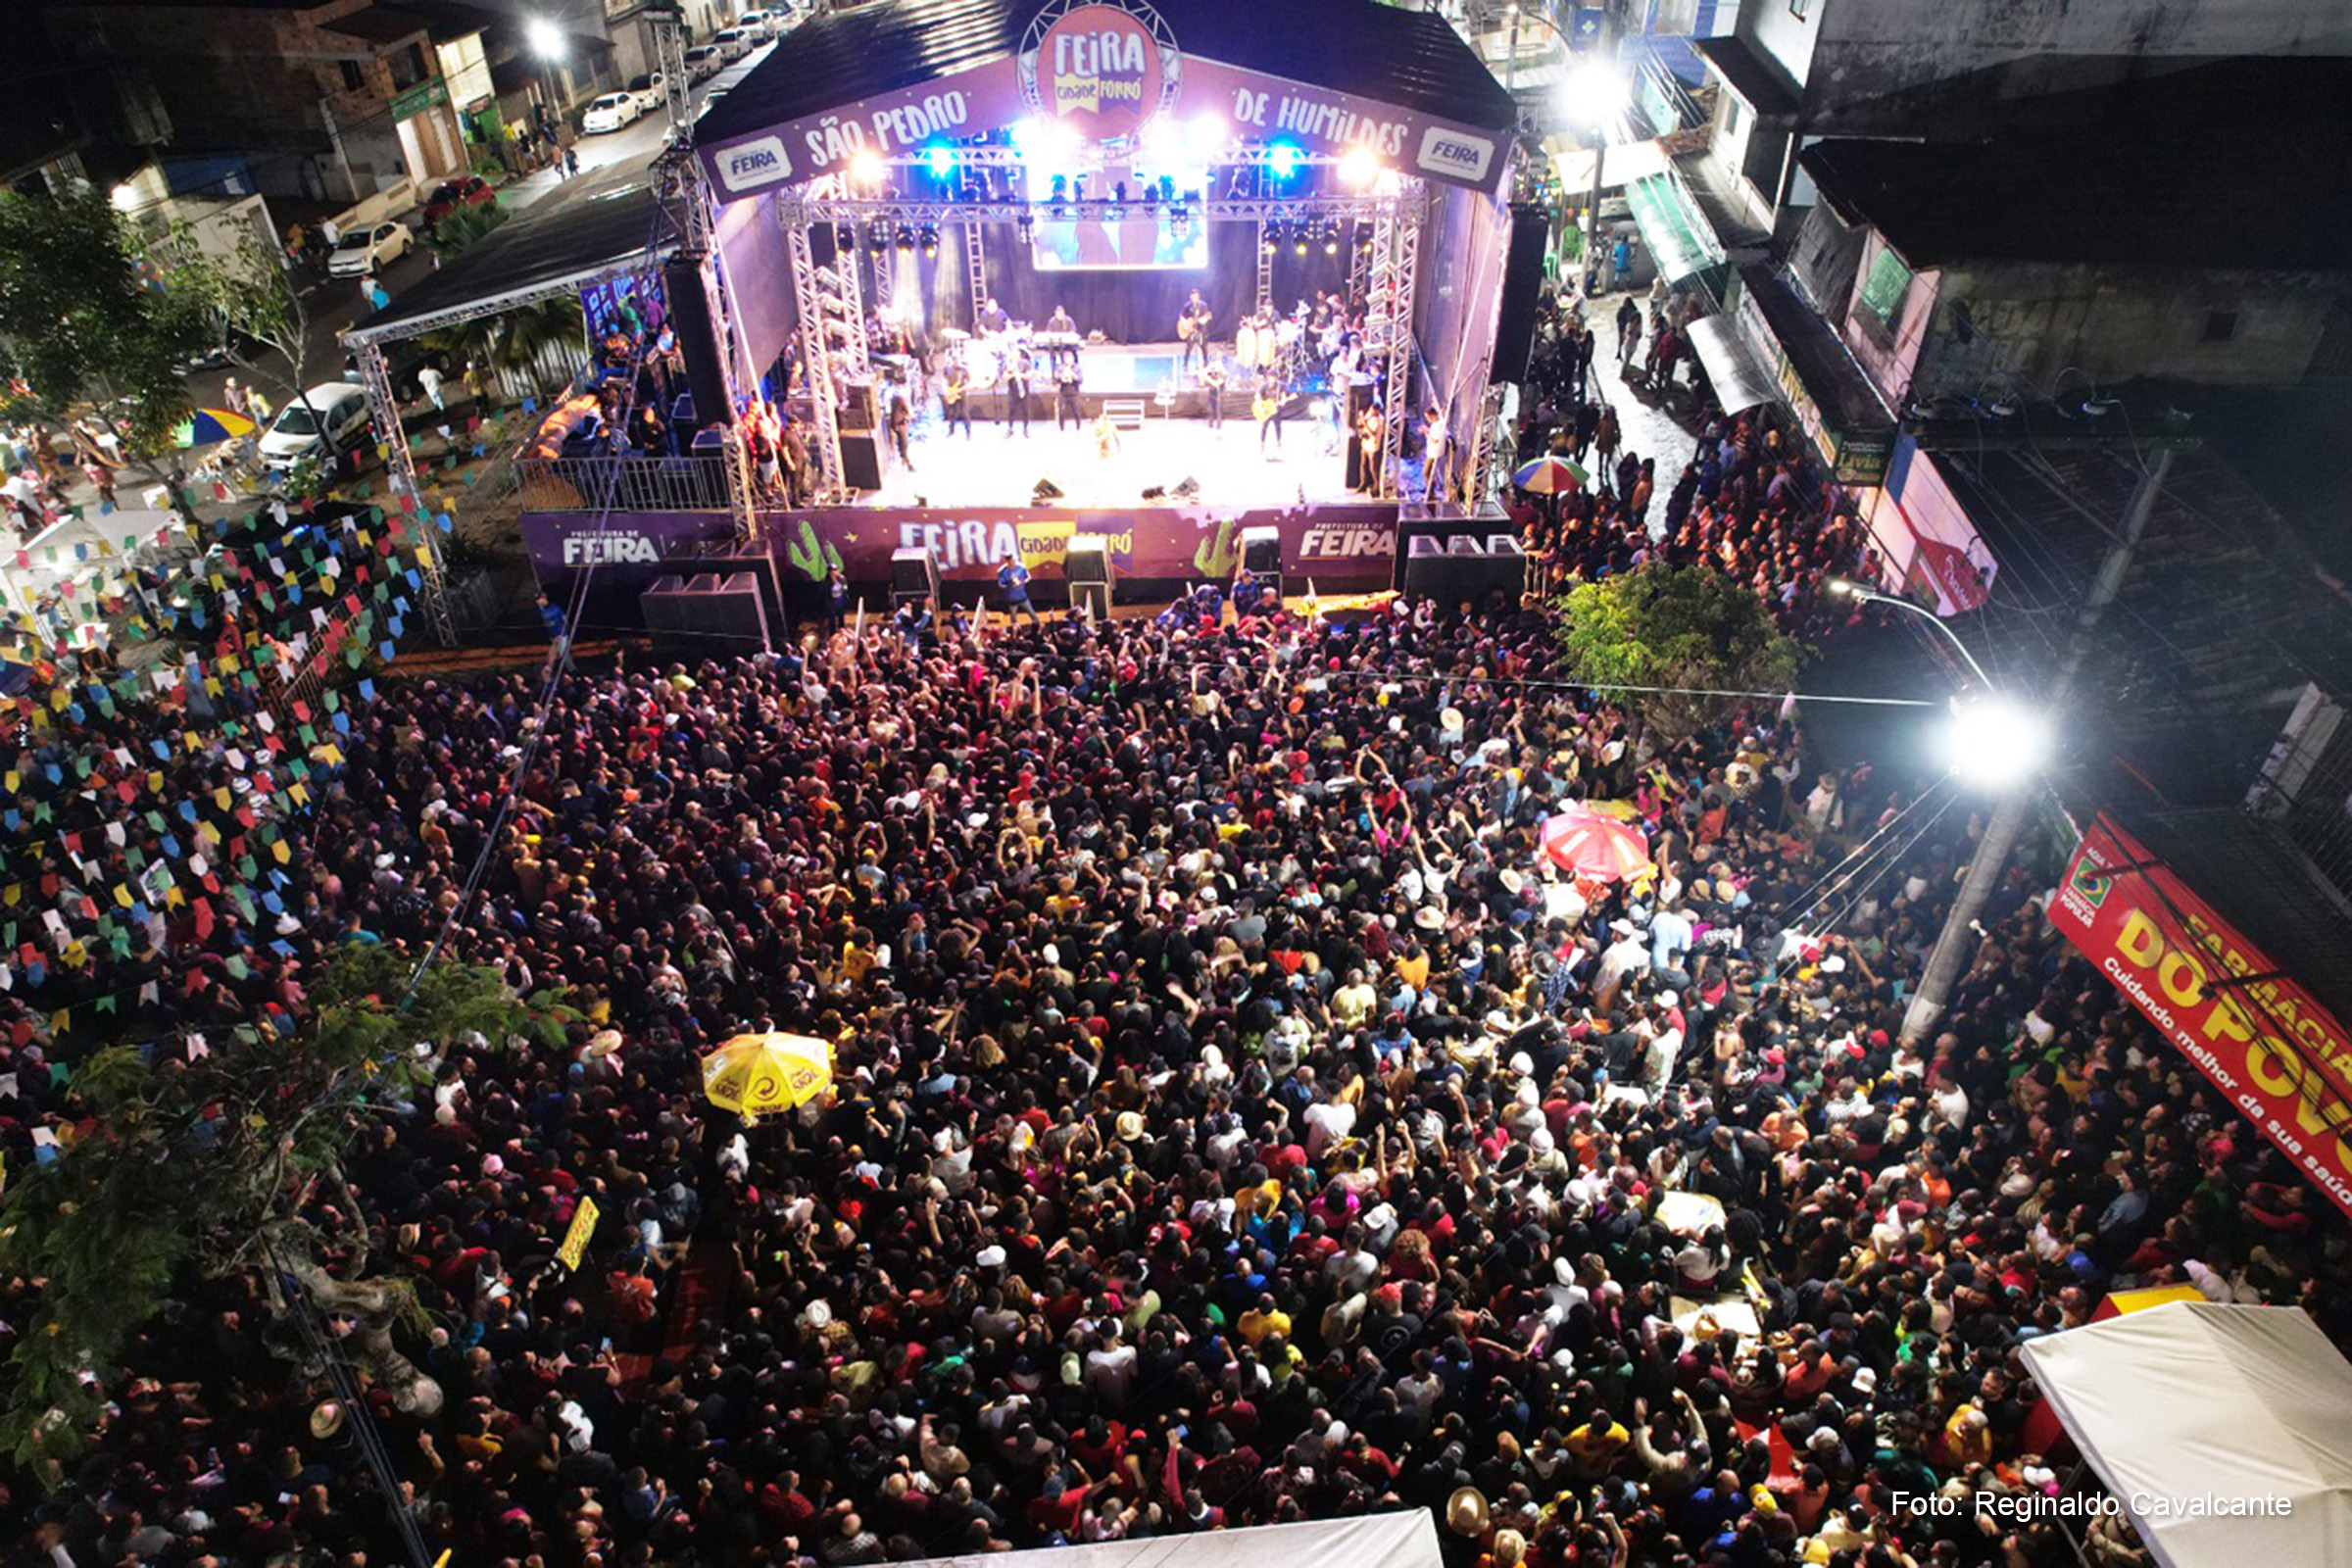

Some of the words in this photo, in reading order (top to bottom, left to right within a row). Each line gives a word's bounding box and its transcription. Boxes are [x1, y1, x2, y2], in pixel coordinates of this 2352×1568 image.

[1234, 87, 1270, 126] DE
[805, 115, 866, 168] SÃO
[871, 90, 968, 152] PEDRO
[730, 150, 779, 176] FEIRA
[1431, 140, 1480, 167] FEIRA
[564, 537, 660, 564] FEIRA
[1298, 530, 1396, 557] FEIRA
[2060, 894, 2094, 929] POPULAR
[2115, 906, 2207, 1008] DO
[2104, 956, 2176, 1030] Cuidando
[2176, 1030, 2238, 1090] melhor
[2238, 1092, 2265, 1119] da
[2267, 1119, 2303, 1155] sua
